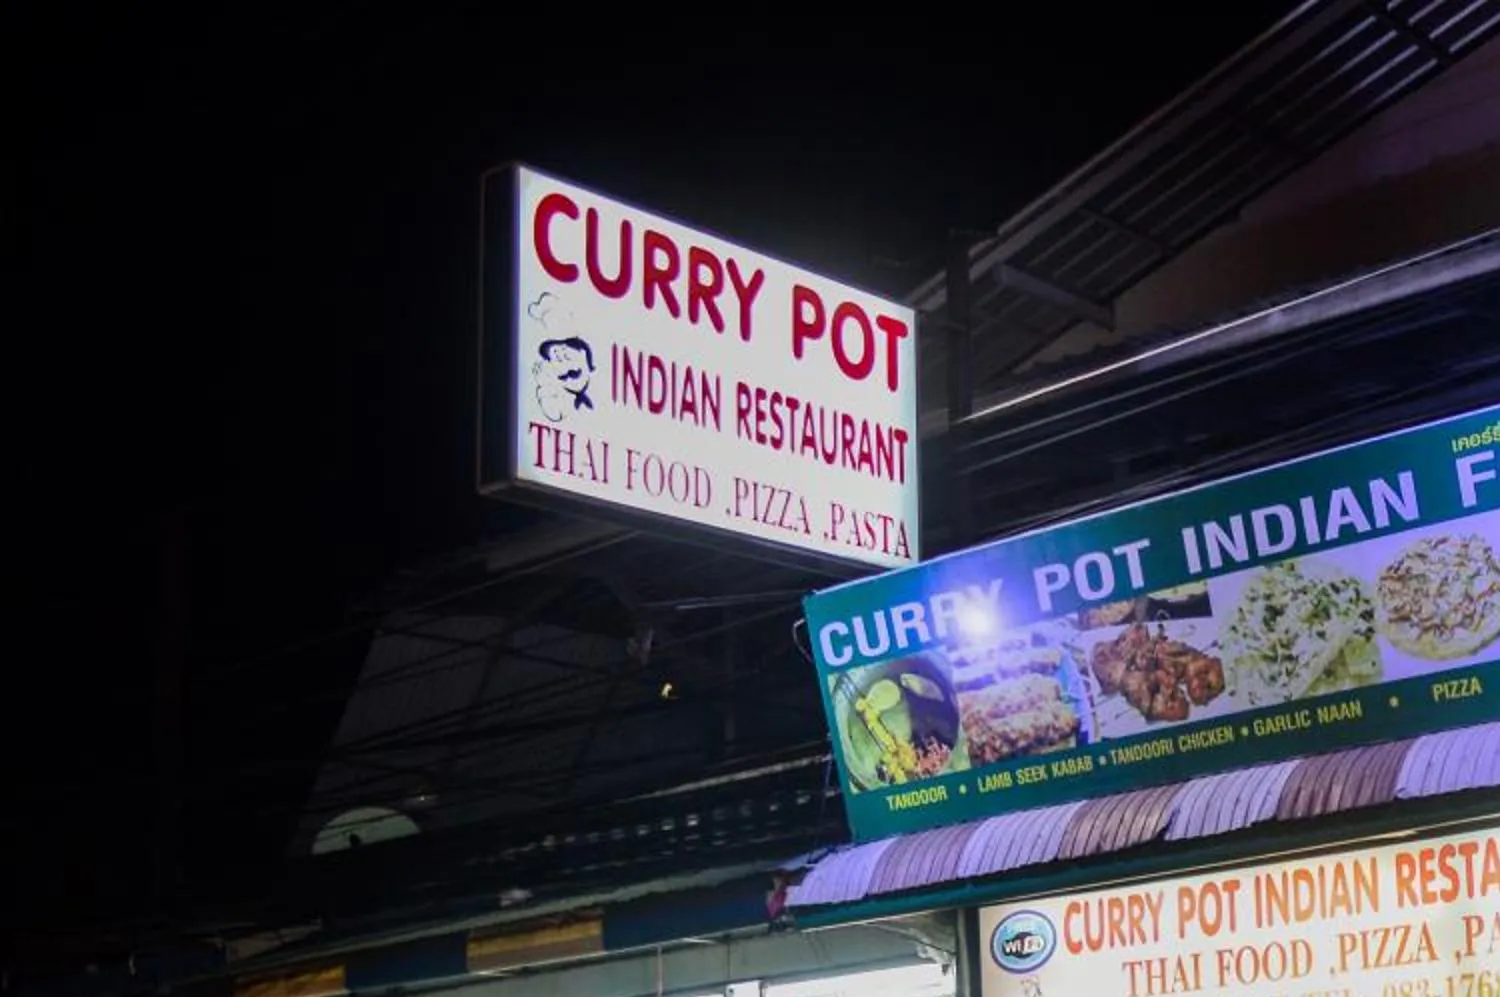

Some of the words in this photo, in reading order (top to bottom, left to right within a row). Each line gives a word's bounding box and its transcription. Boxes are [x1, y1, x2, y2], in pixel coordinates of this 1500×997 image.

[533, 193, 765, 342] CURRY
[792, 284, 908, 392] POT
[529, 421, 610, 484] THAI
[626, 448, 712, 509] FOOD
[610, 343, 721, 432] INDIAN
[736, 381, 908, 485] RESTAURANT
[818, 577, 1004, 668] CURRY
[1032, 538, 1151, 612] POT
[1181, 470, 1419, 576] INDIAN
[886, 785, 948, 812] TANDOOR
[977, 773, 1013, 795] LAMB
[1016, 767, 1048, 787] SEEK
[1051, 755, 1093, 779] KABAB
[1110, 739, 1175, 767] TANDOORI
[1178, 725, 1234, 751] CHICKEN
[1253, 711, 1312, 738] GARLIC
[1317, 700, 1363, 725] NAAN
[1432, 676, 1483, 702] PIZZA
[1063, 889, 1164, 956] CURRY
[1178, 878, 1241, 941] POT
[1254, 856, 1379, 929] INDIAN
[1216, 937, 1313, 988] FOOD
